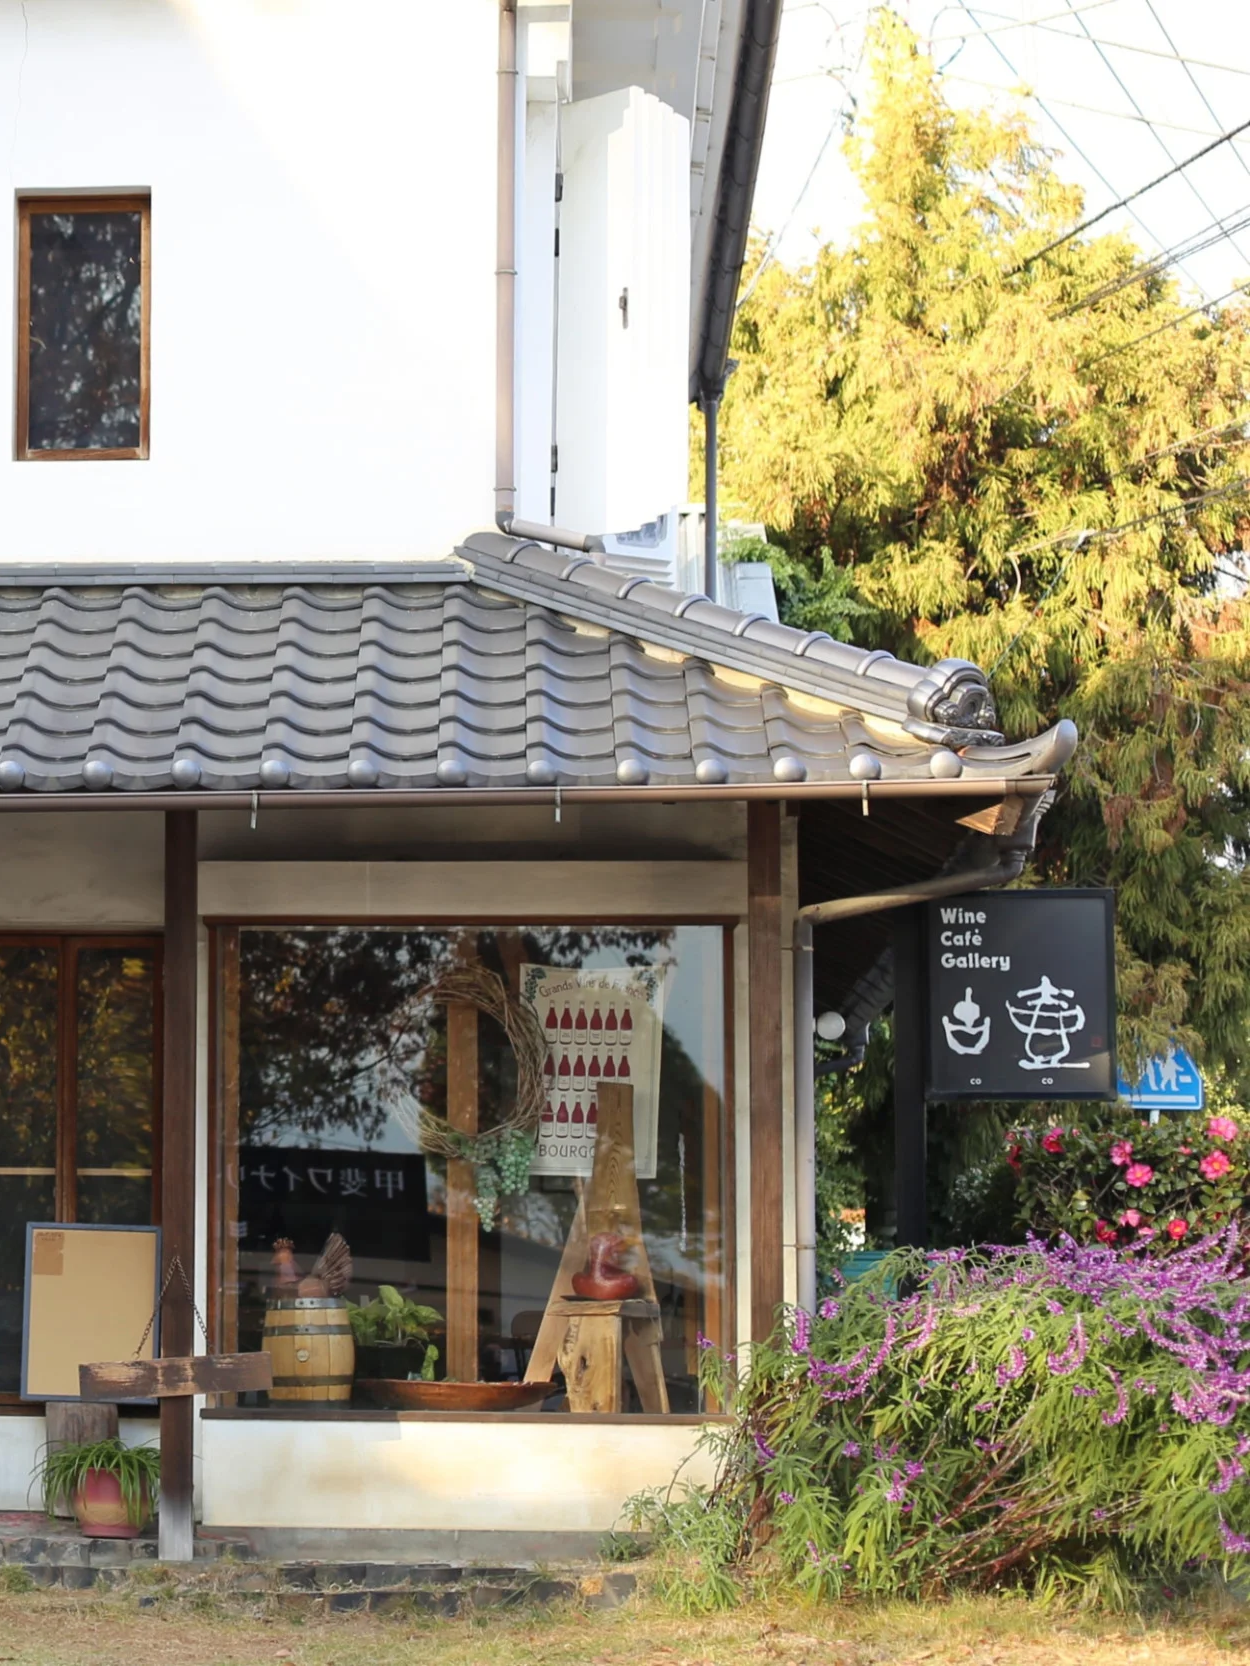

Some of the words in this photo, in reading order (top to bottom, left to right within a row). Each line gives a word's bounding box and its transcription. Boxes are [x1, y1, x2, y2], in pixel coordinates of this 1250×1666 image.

[940, 907, 987, 924] Wine
[940, 952, 1011, 972] Gallery
[538, 980, 573, 998] Grands
[599, 974, 610, 990] de
[970, 1077, 982, 1085] co
[1041, 1077, 1054, 1085] co
